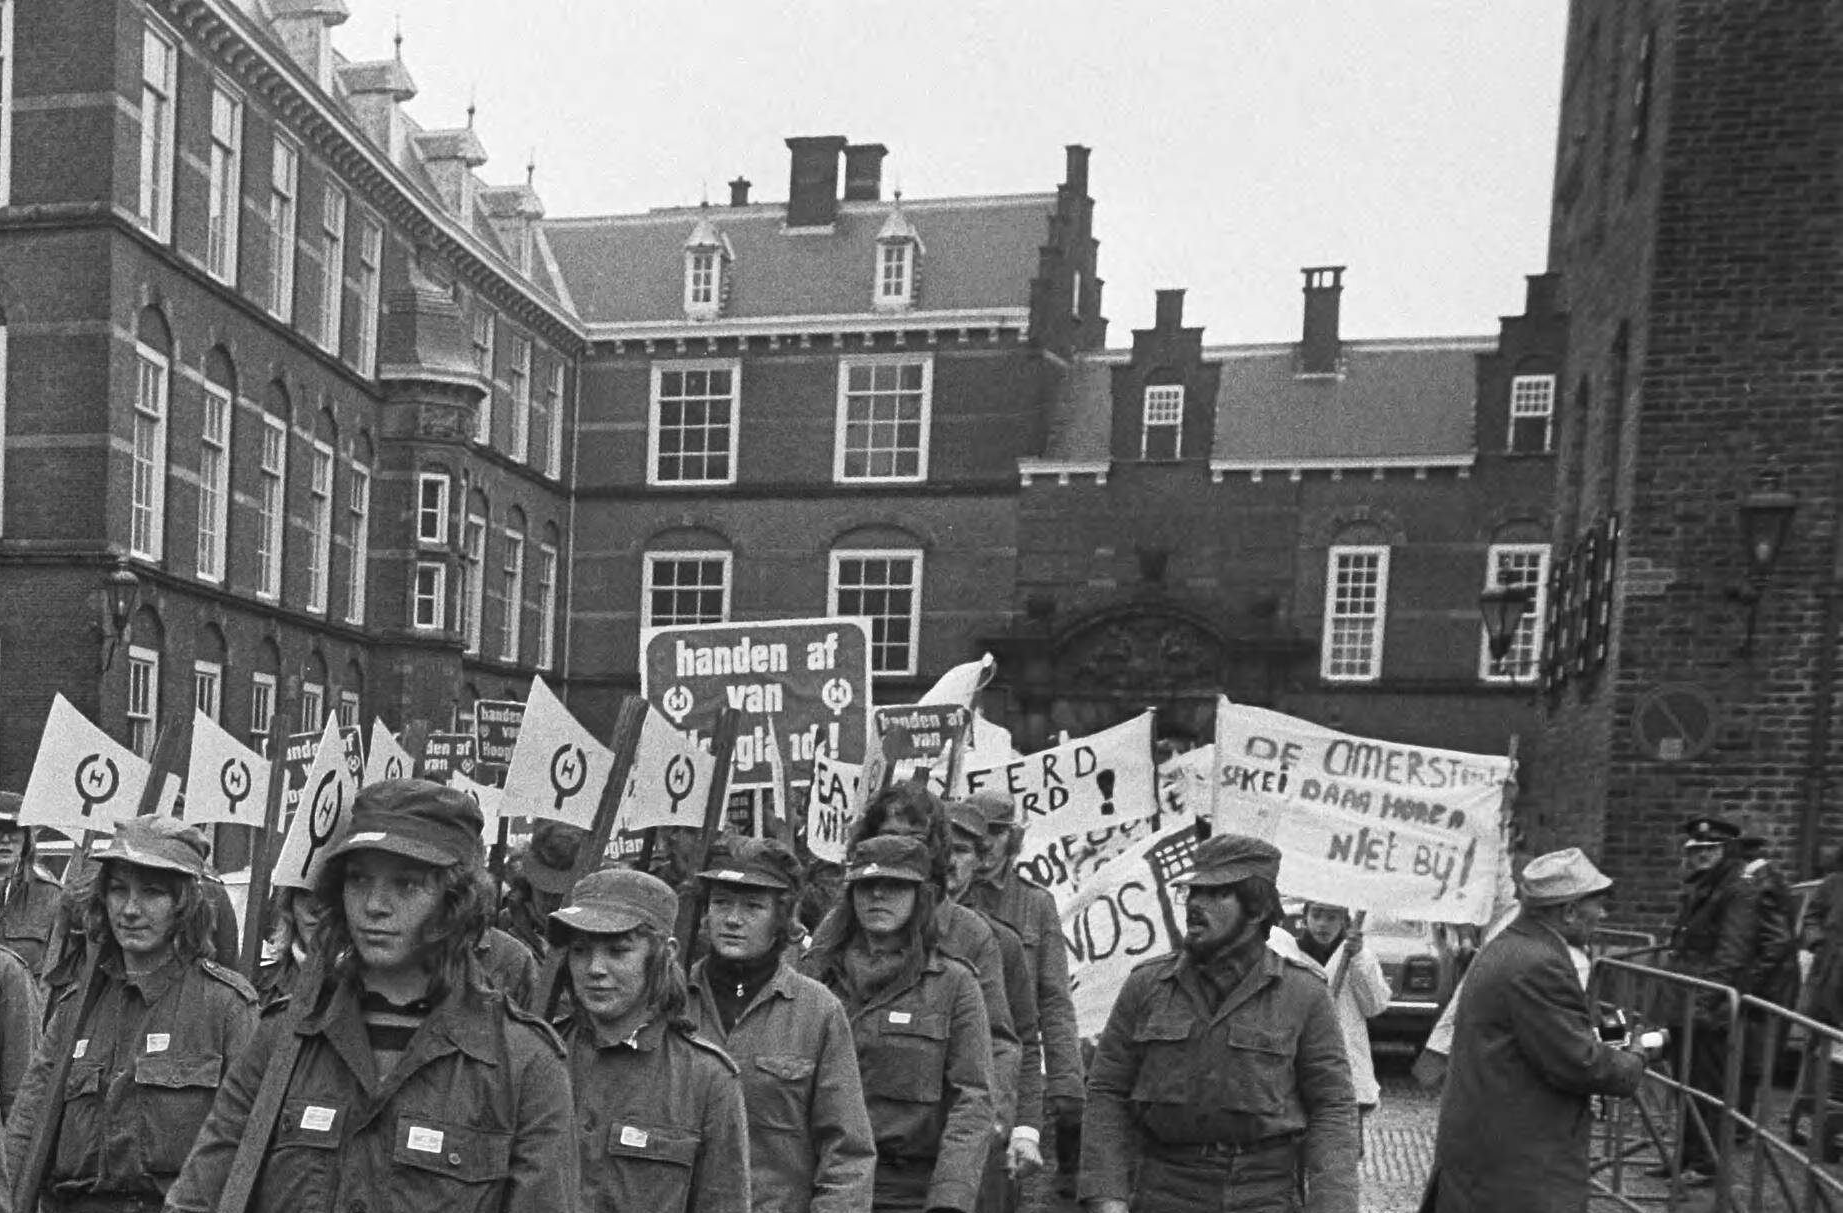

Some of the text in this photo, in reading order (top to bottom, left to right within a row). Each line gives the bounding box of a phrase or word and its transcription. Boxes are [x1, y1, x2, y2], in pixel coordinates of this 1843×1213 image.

[676, 632, 839, 677] handen af
[726, 683, 784, 713] van
[911, 732, 941, 748] van
